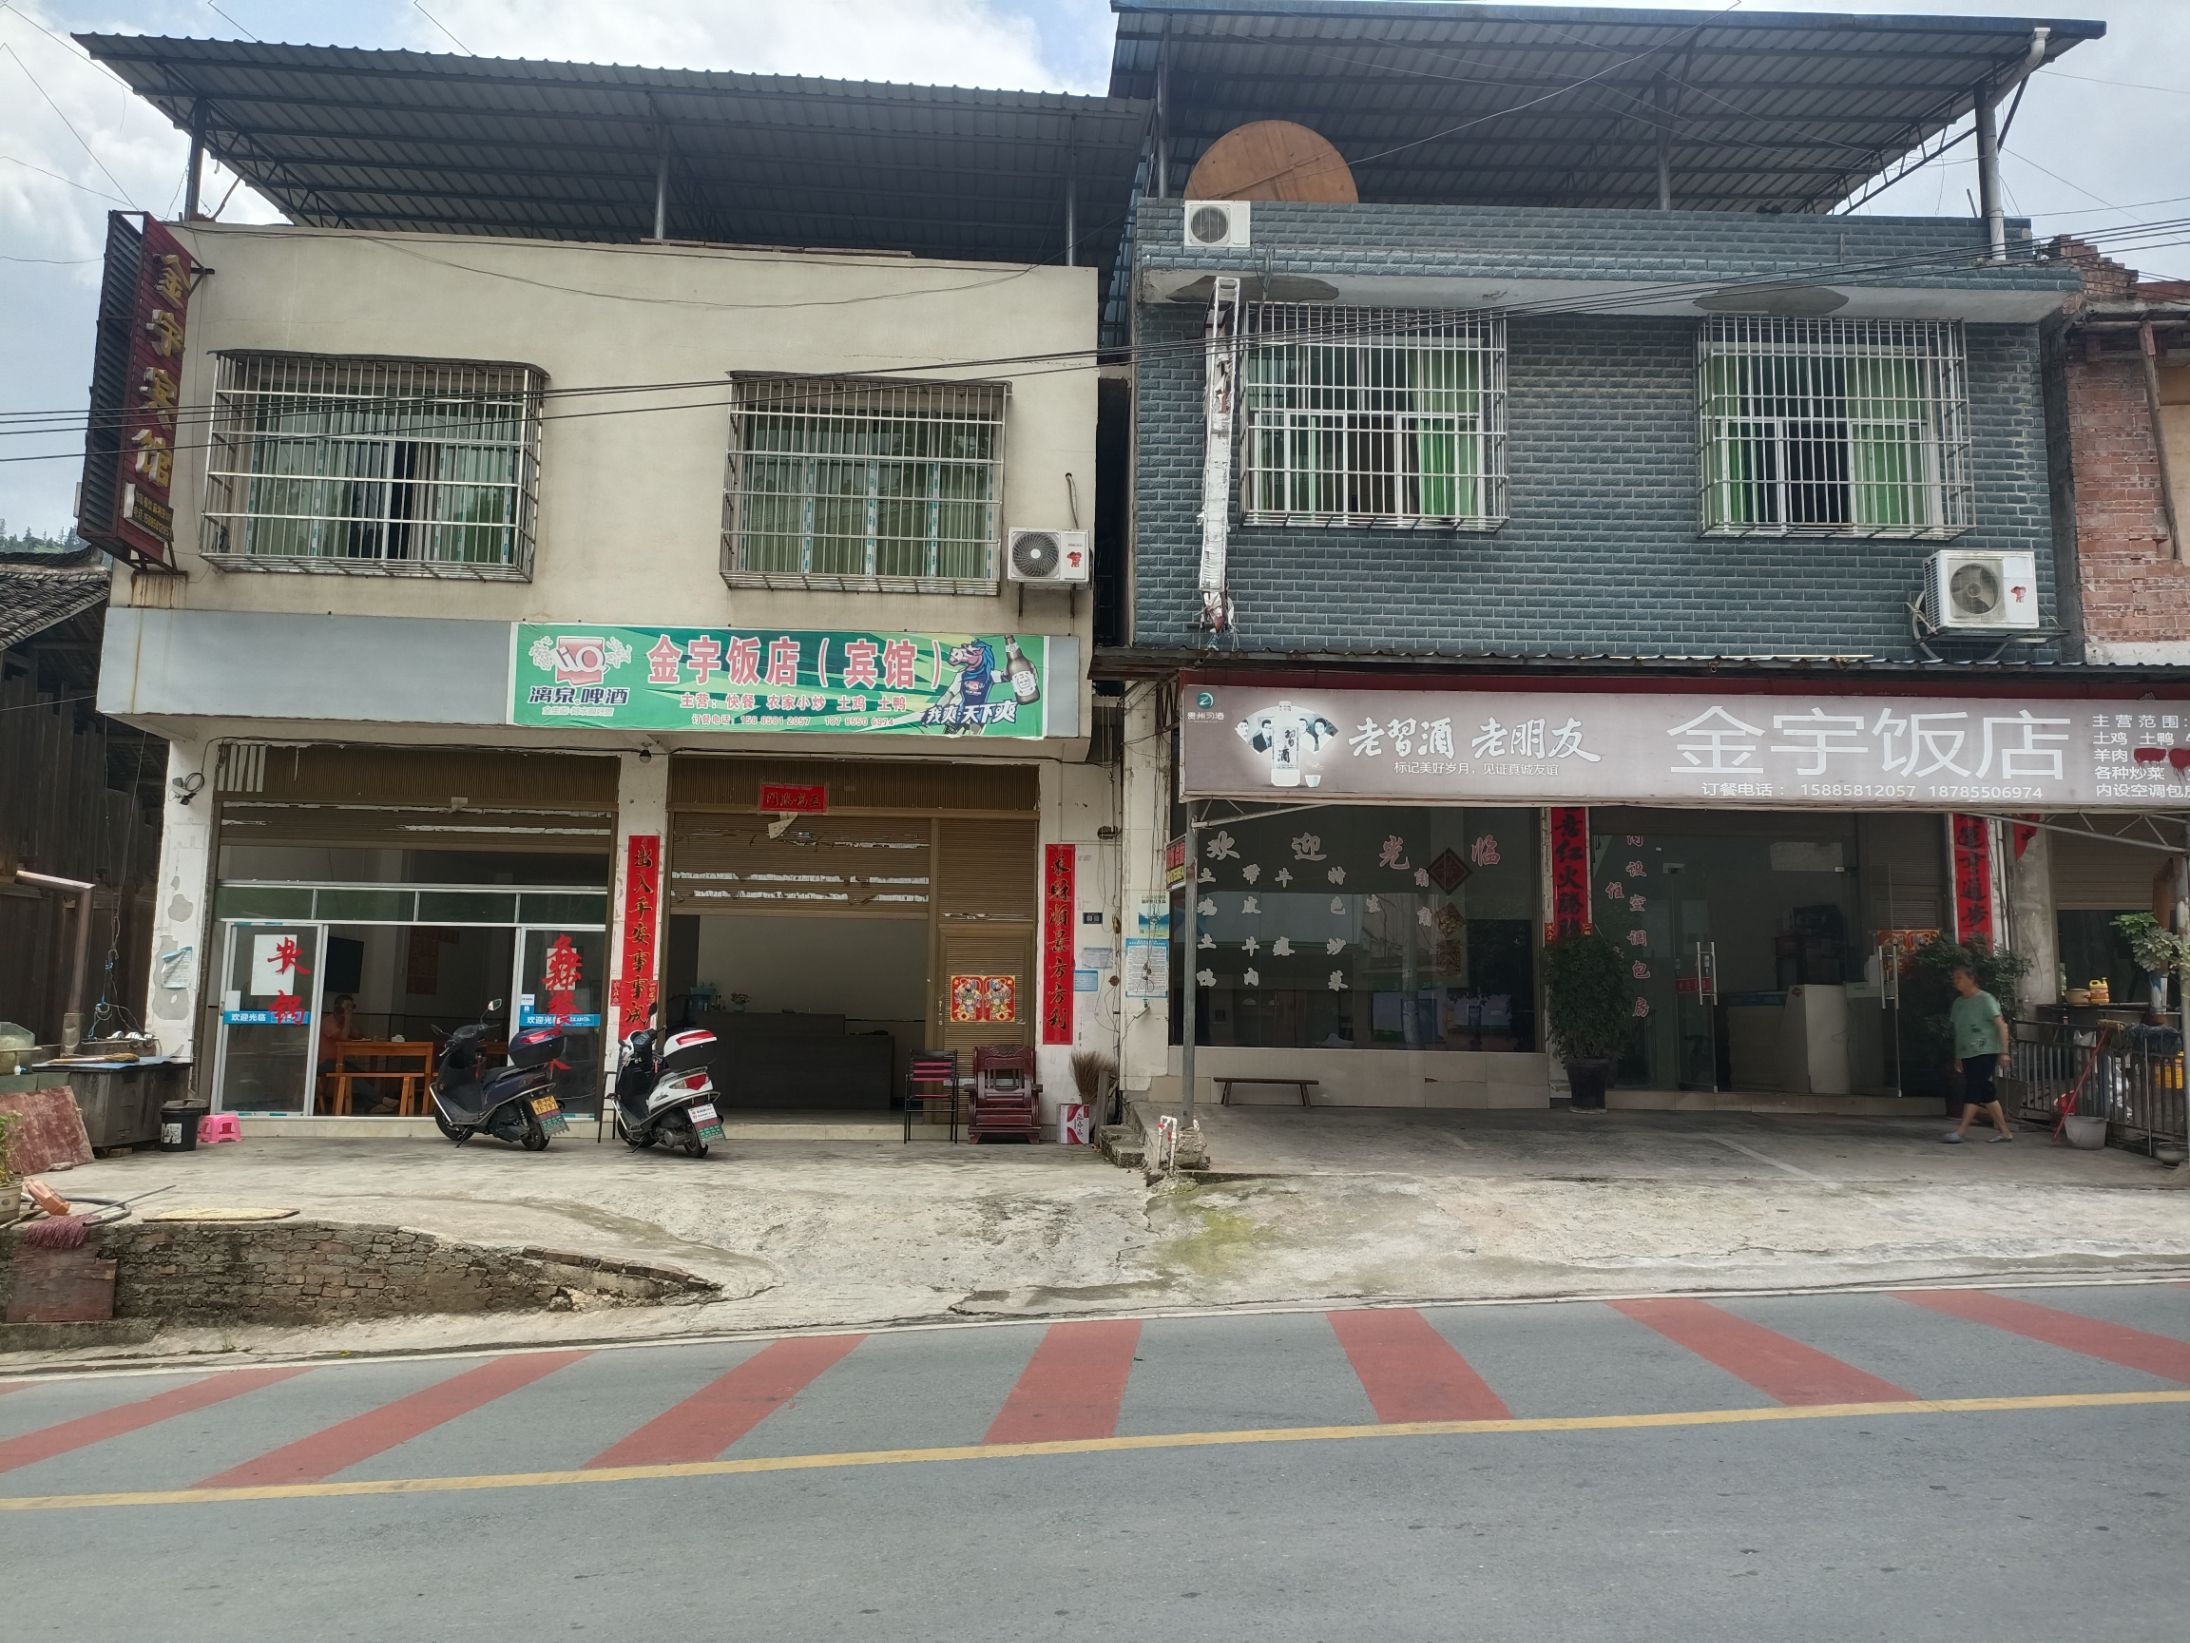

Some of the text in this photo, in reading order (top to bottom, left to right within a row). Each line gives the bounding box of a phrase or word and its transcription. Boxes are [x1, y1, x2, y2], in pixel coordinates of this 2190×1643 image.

[132, 253, 191, 488] 金宇宾馆
[726, 693, 756, 709] 快餐
[766, 694, 826, 711] 农家小炒
[836, 695, 866, 711] 土鸡
[876, 696, 907, 712] 土鸭
[1471, 718, 1602, 762] 老朋友
[1666, 705, 2071, 782] 金宇饭店
[2093, 732, 2175, 746] 土鸡 土鸭
[2094, 748, 2128, 762] 羊肉
[2095, 766, 2165, 781] 各种炒菜
[1800, 784, 1916, 798] 15885812057
[1929, 785, 2043, 800] 18785506974
[1206, 830, 1501, 871] 欢迎光临
[231, 1012, 266, 1022] 欢迎光临
